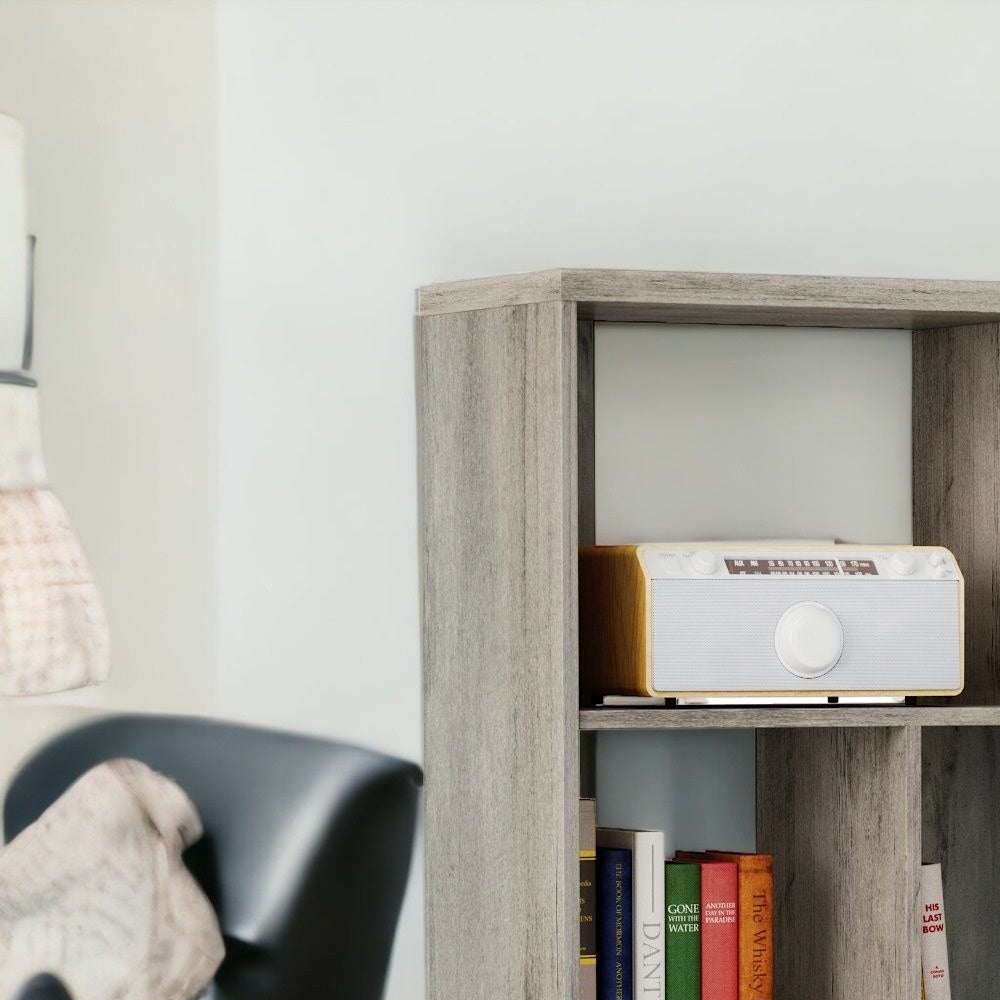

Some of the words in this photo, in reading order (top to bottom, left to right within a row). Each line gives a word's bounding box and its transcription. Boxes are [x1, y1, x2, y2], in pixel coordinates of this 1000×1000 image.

[615, 904, 622, 915] OF
[667, 903, 700, 914] GONE
[752, 890, 766, 922] The
[925, 903, 939, 912] HIS
[705, 916, 736, 924] PARADISE
[923, 913, 942, 923] LAST
[668, 923, 700, 933] WATER
[922, 923, 944, 934] BOW
[749, 927, 767, 996] Whisky
